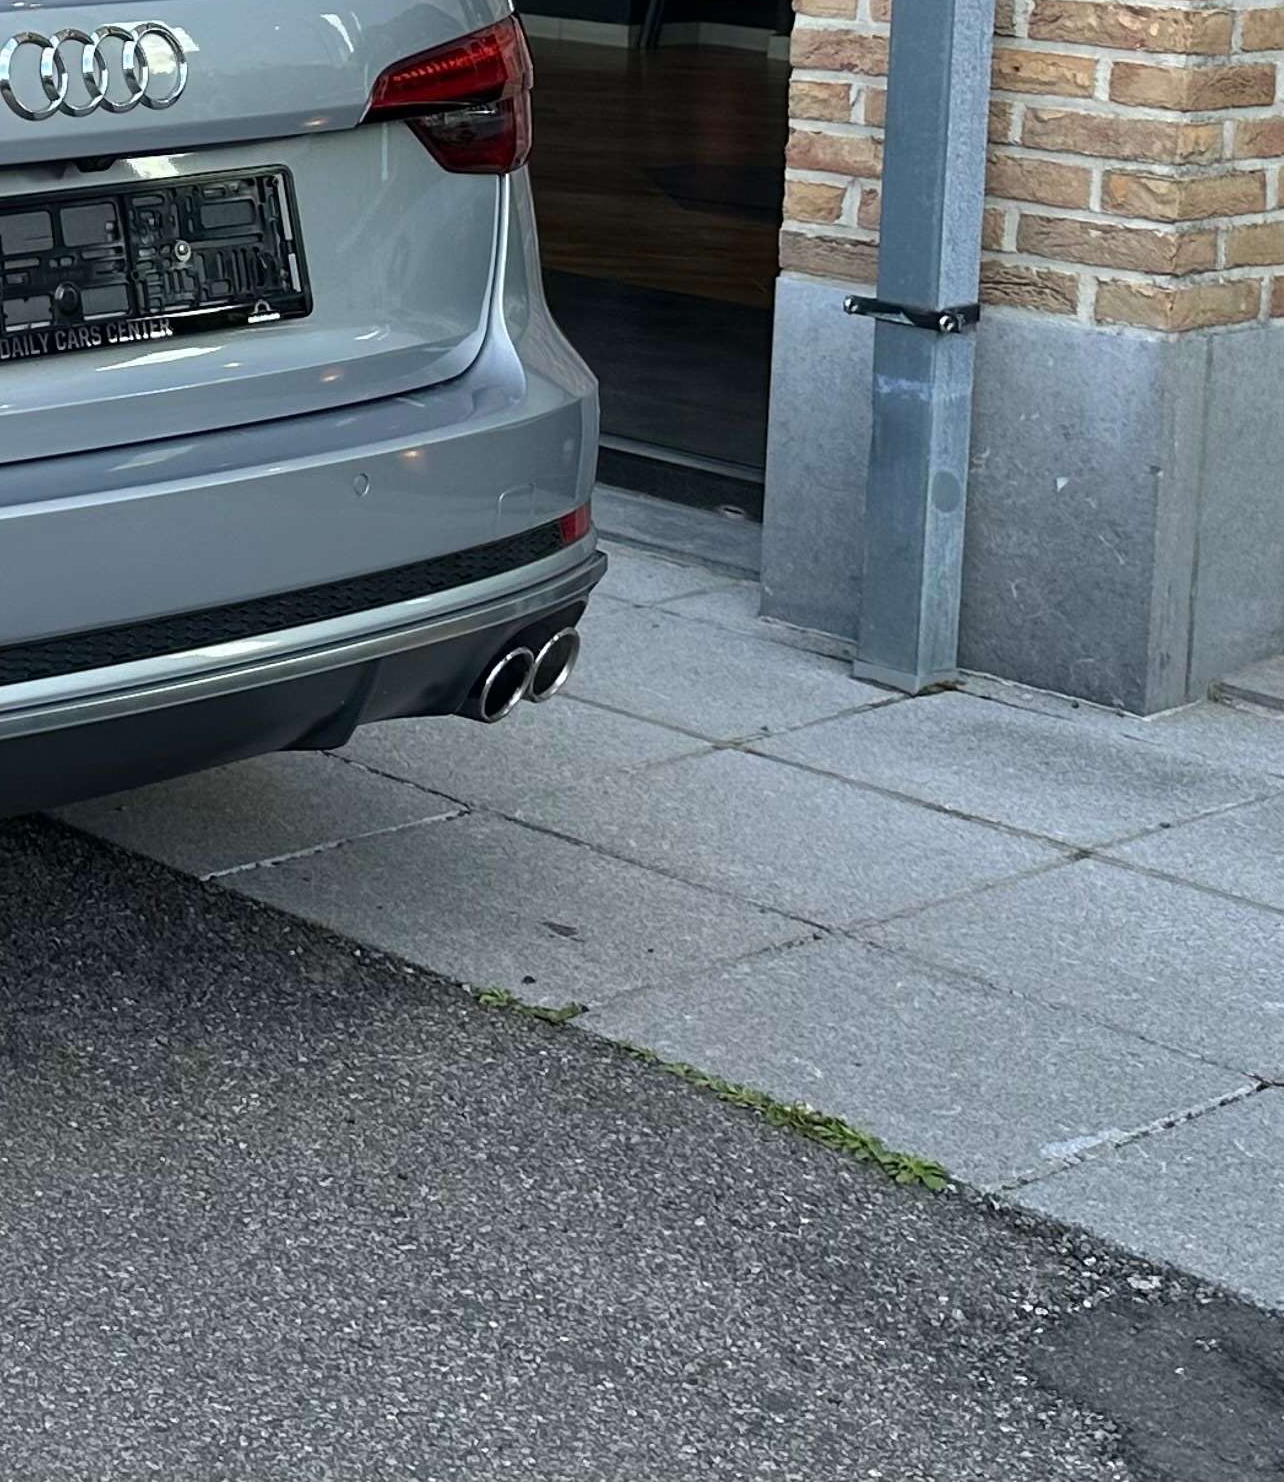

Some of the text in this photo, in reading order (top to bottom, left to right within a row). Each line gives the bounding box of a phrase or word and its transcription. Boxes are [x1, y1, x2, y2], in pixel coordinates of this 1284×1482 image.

[0, 317, 173, 360] DAILY CARS CENTER
